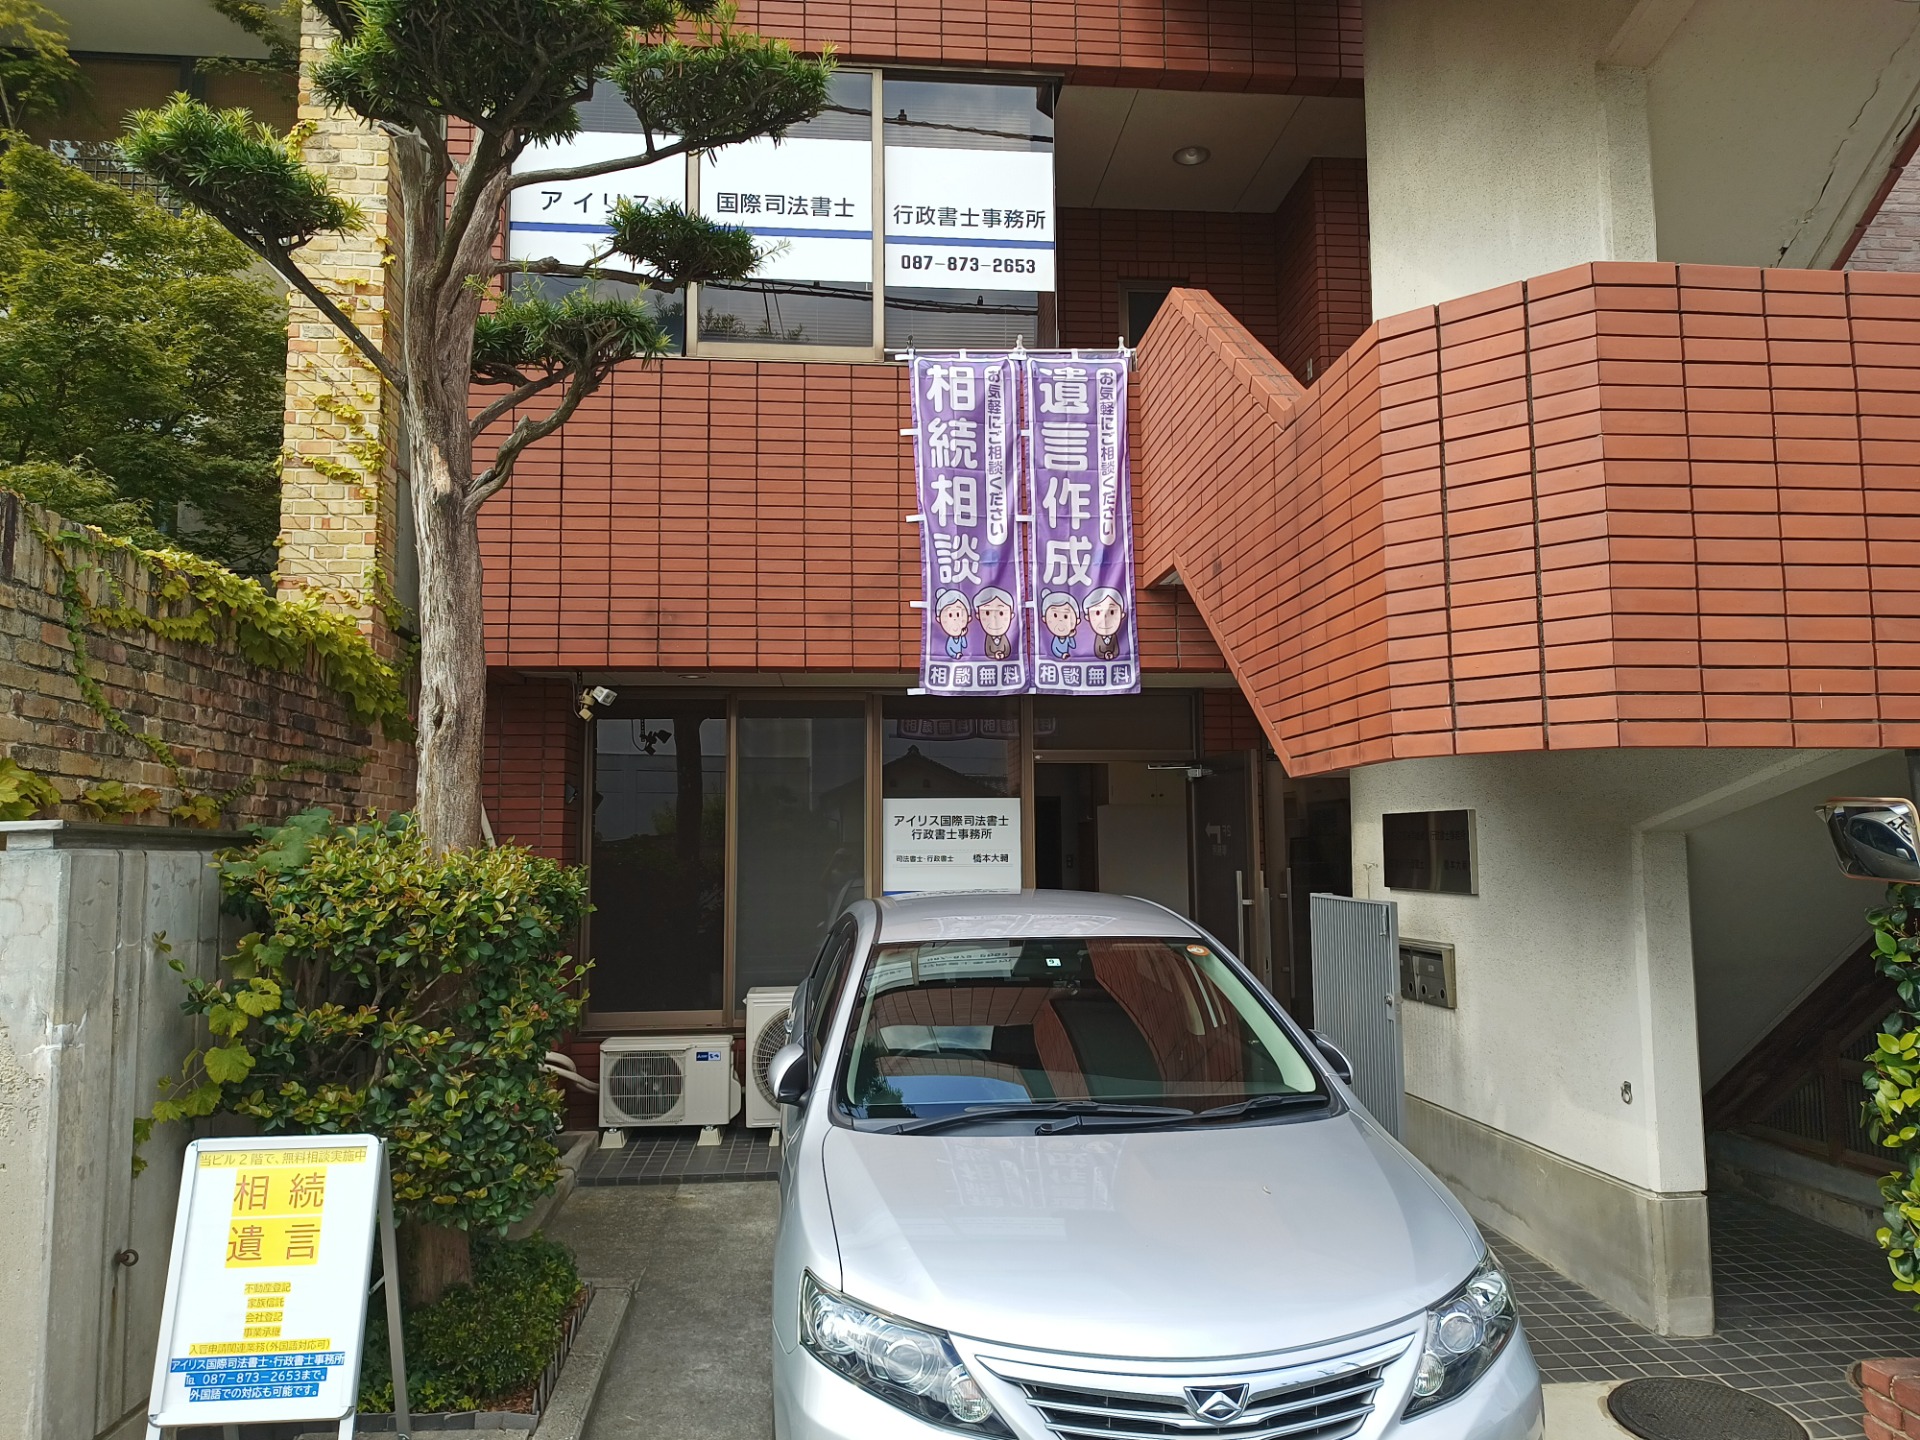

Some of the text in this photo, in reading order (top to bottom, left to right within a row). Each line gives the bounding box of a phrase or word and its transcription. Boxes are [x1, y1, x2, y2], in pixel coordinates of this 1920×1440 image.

[716, 191, 855, 218] 国際司法書士
[893, 204, 1047, 230] 行政書士事務所
[900, 254, 1037, 274] 087-873-2653
[987, 369, 1006, 536] お気軽にご相談ください
[926, 364, 982, 585] 相続相談
[1038, 366, 1093, 587] 遺言作成
[930, 667, 1020, 686] 相談無料
[1040, 665, 1131, 684] 相談無料
[894, 815, 1009, 827] アイリス国際司法書士
[911, 828, 993, 840] 行政書士事務所
[244, 1282, 291, 1293] 不動産登記
[247, 1297, 284, 1308] 家族信託
[245, 1311, 282, 1322] 会社登記
[243, 1326, 281, 1338] 事業承継
[190, 1385, 318, 1401] 外国語での対応も可能です。
